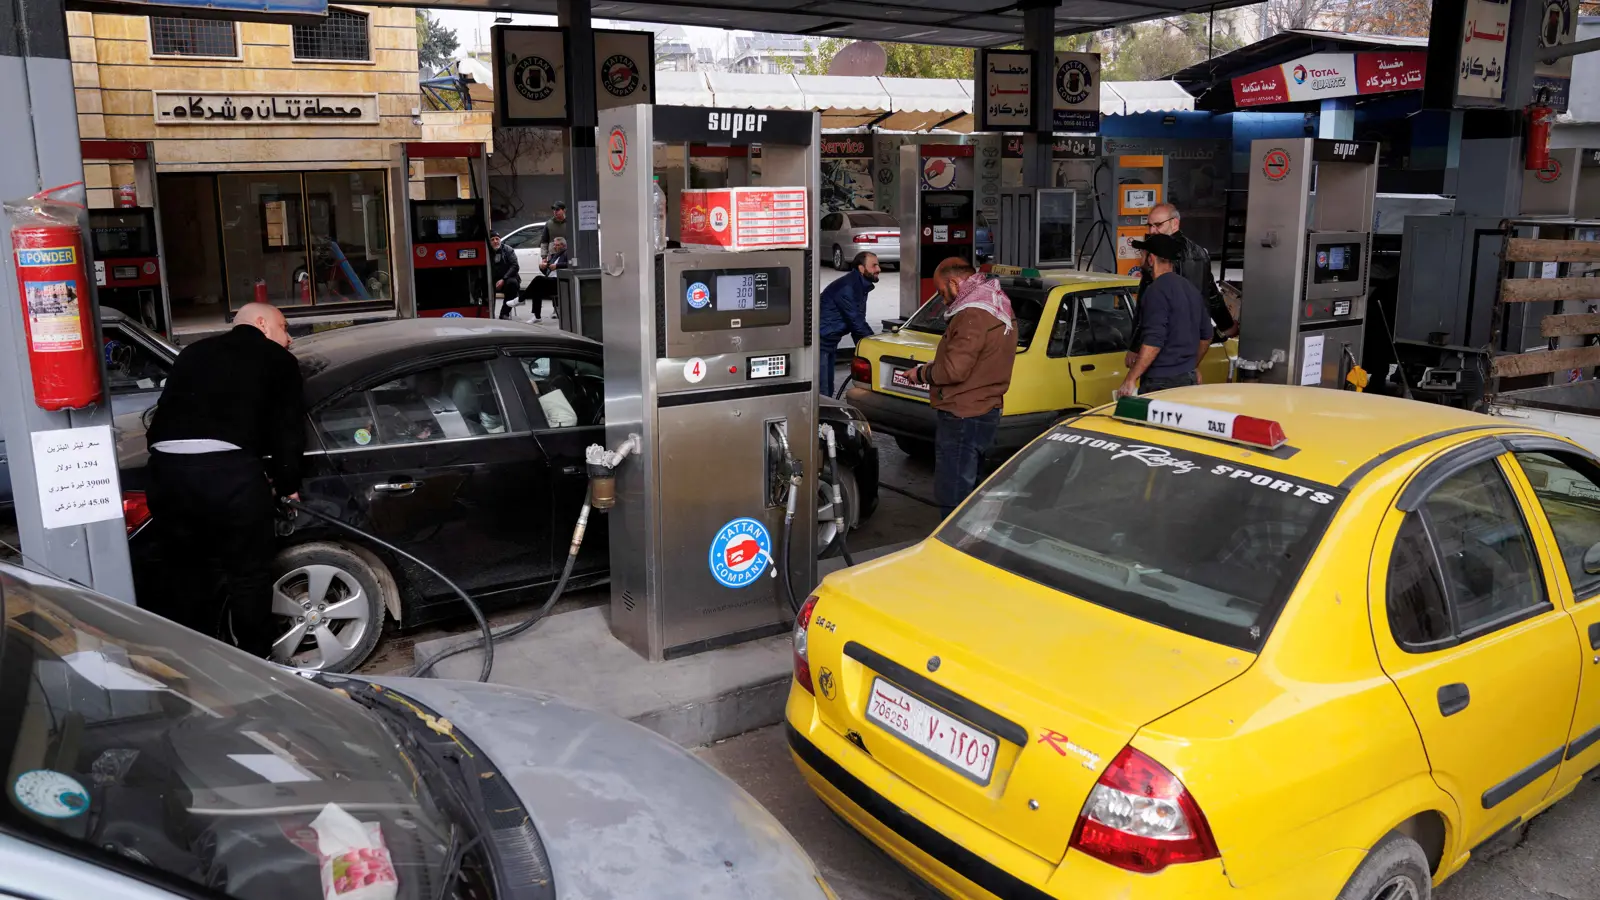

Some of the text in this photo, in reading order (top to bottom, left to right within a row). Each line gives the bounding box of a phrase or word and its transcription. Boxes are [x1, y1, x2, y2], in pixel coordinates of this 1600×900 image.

[1464, 20, 1506, 43] تتان
[519, 57, 549, 71] TATTAN
[605, 55, 634, 68] TATTAN
[990, 63, 1028, 74] محطة
[1061, 61, 1087, 74] TATTAN
[1377, 59, 1404, 69] مغسلة
[1309, 68, 1340, 78] TOTAL
[1366, 70, 1422, 89] تتان وشركاه
[990, 84, 1028, 96] تتان
[1260, 79, 1277, 91] خدمة
[1311, 77, 1346, 91] QUARTZ
[257, 97, 300, 120] تتان
[304, 98, 362, 119] محطة
[989, 103, 1028, 116] وشركاؤه
[708, 112, 767, 138] super
[820, 138, 865, 153] Service
[1333, 142, 1360, 160] super
[715, 212, 723, 221] 12
[27, 251, 72, 263] POWDER
[692, 362, 700, 376] 4
[1207, 420, 1226, 434] TAXI
[47, 443, 70, 454] البنزين
[72, 441, 84, 450] ليتر
[55, 460, 98, 472] 1.294 دولار
[1047, 432, 1121, 452] MOTOR
[1210, 464, 1335, 506] SPORTS
[48, 478, 110, 493] 39000 ليرة سوري
[54, 497, 110, 512] 45.08 ليرة تركي
[720, 522, 762, 541] TATTAN
[716, 557, 763, 583] COMPANY
[876, 688, 910, 712] حلب
[873, 700, 909, 731] 706259
[929, 715, 990, 772] ٧٠٦٢٥٩
